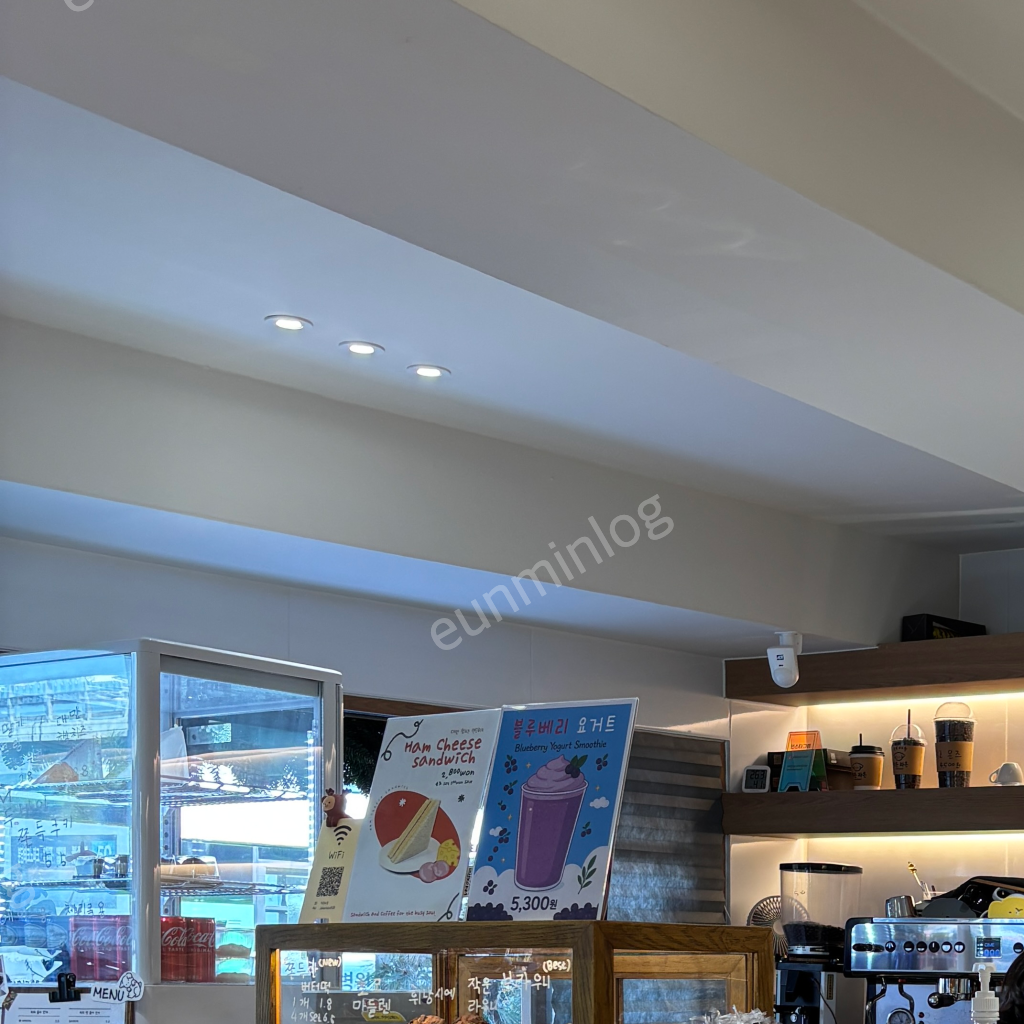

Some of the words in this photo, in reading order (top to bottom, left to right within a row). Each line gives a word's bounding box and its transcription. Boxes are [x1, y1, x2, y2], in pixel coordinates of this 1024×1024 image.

[513, 718, 569, 739] 블루베리
[577, 715, 616, 734] 요거트
[405, 741, 431, 753] Ham
[436, 737, 482, 751] Cheese
[515, 743, 547, 753] Blueberry
[550, 741, 572, 752] Yogurt
[574, 739, 607, 749] Smoothie
[328, 850, 345, 860] WiFi
[510, 895, 558, 913] 5,300원
[92, 986, 125, 1001] MENU
[301, 981, 331, 995] 버터떡
[319, 998, 333, 1011] 1.8
[352, 998, 391, 1019] 마들렌
